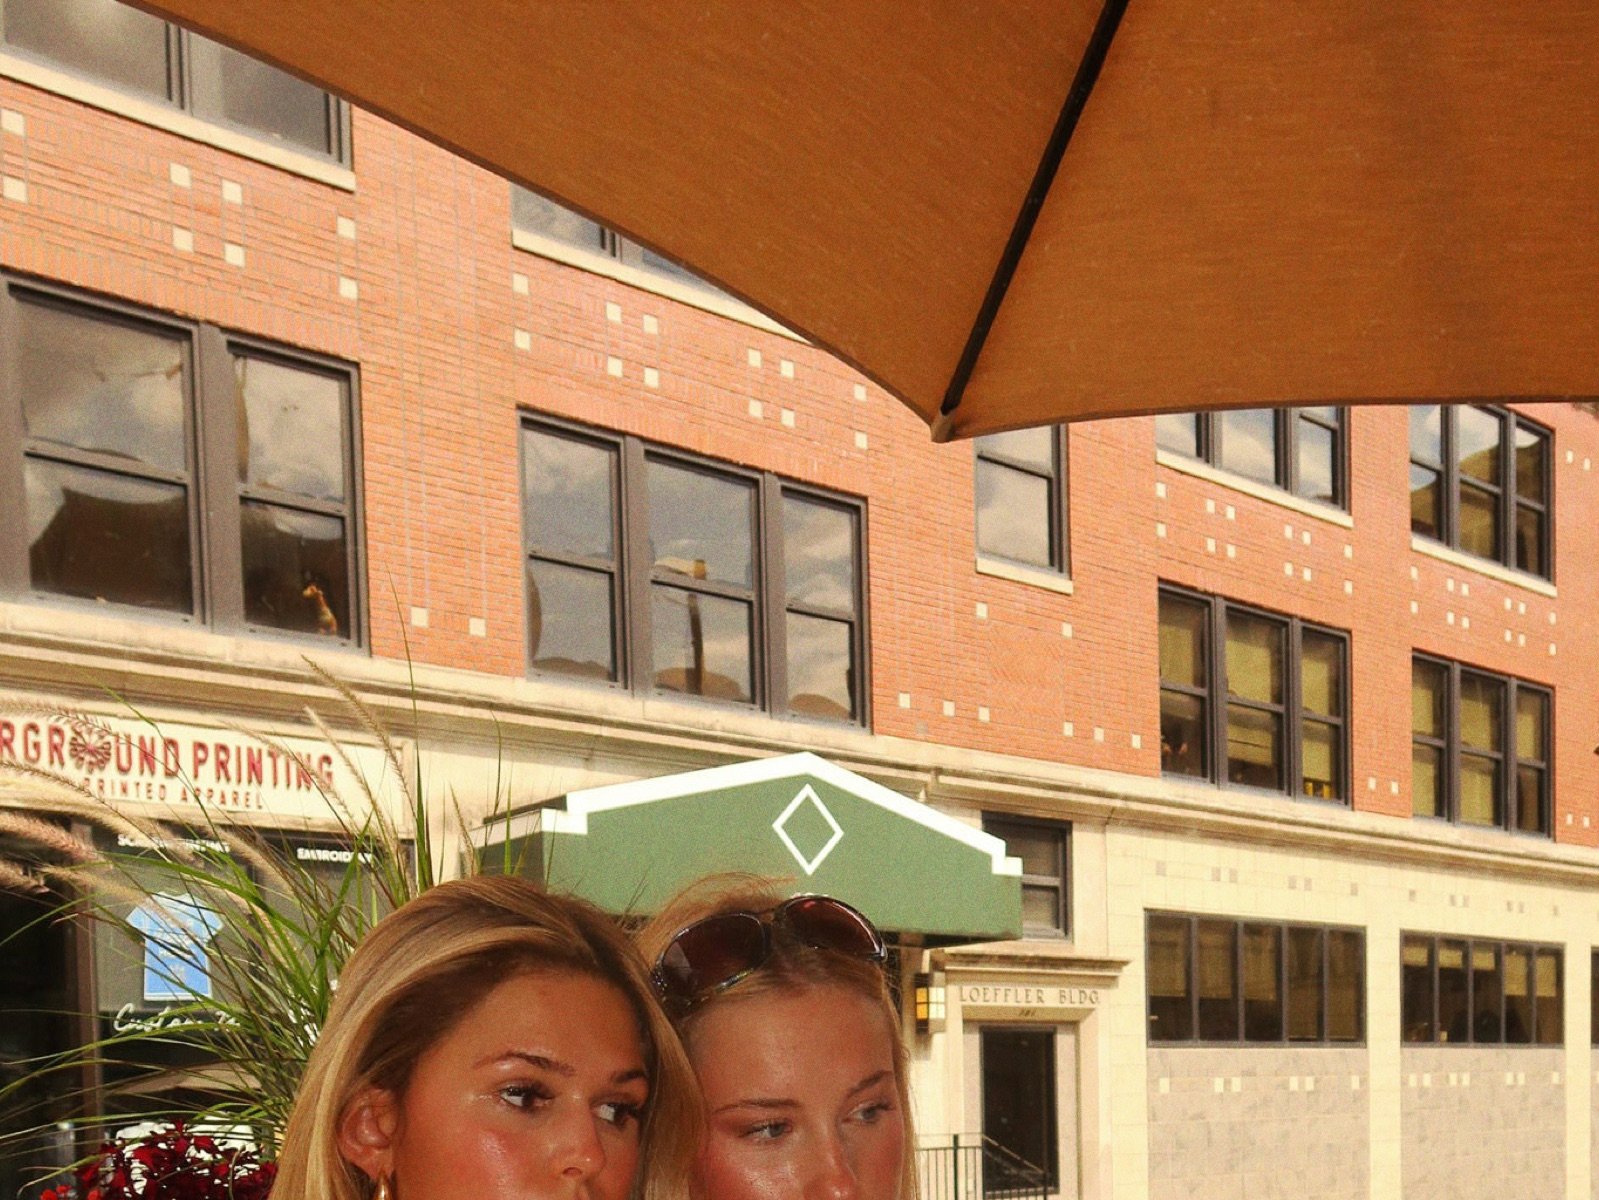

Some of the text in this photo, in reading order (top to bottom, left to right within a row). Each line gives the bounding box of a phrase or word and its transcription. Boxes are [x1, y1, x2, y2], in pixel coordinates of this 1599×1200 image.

[193, 740, 334, 792] PRINTING
[83, 776, 262, 810] PRINTED APPAREL
[959, 986, 1100, 1004] LOEFFLER BLDG
